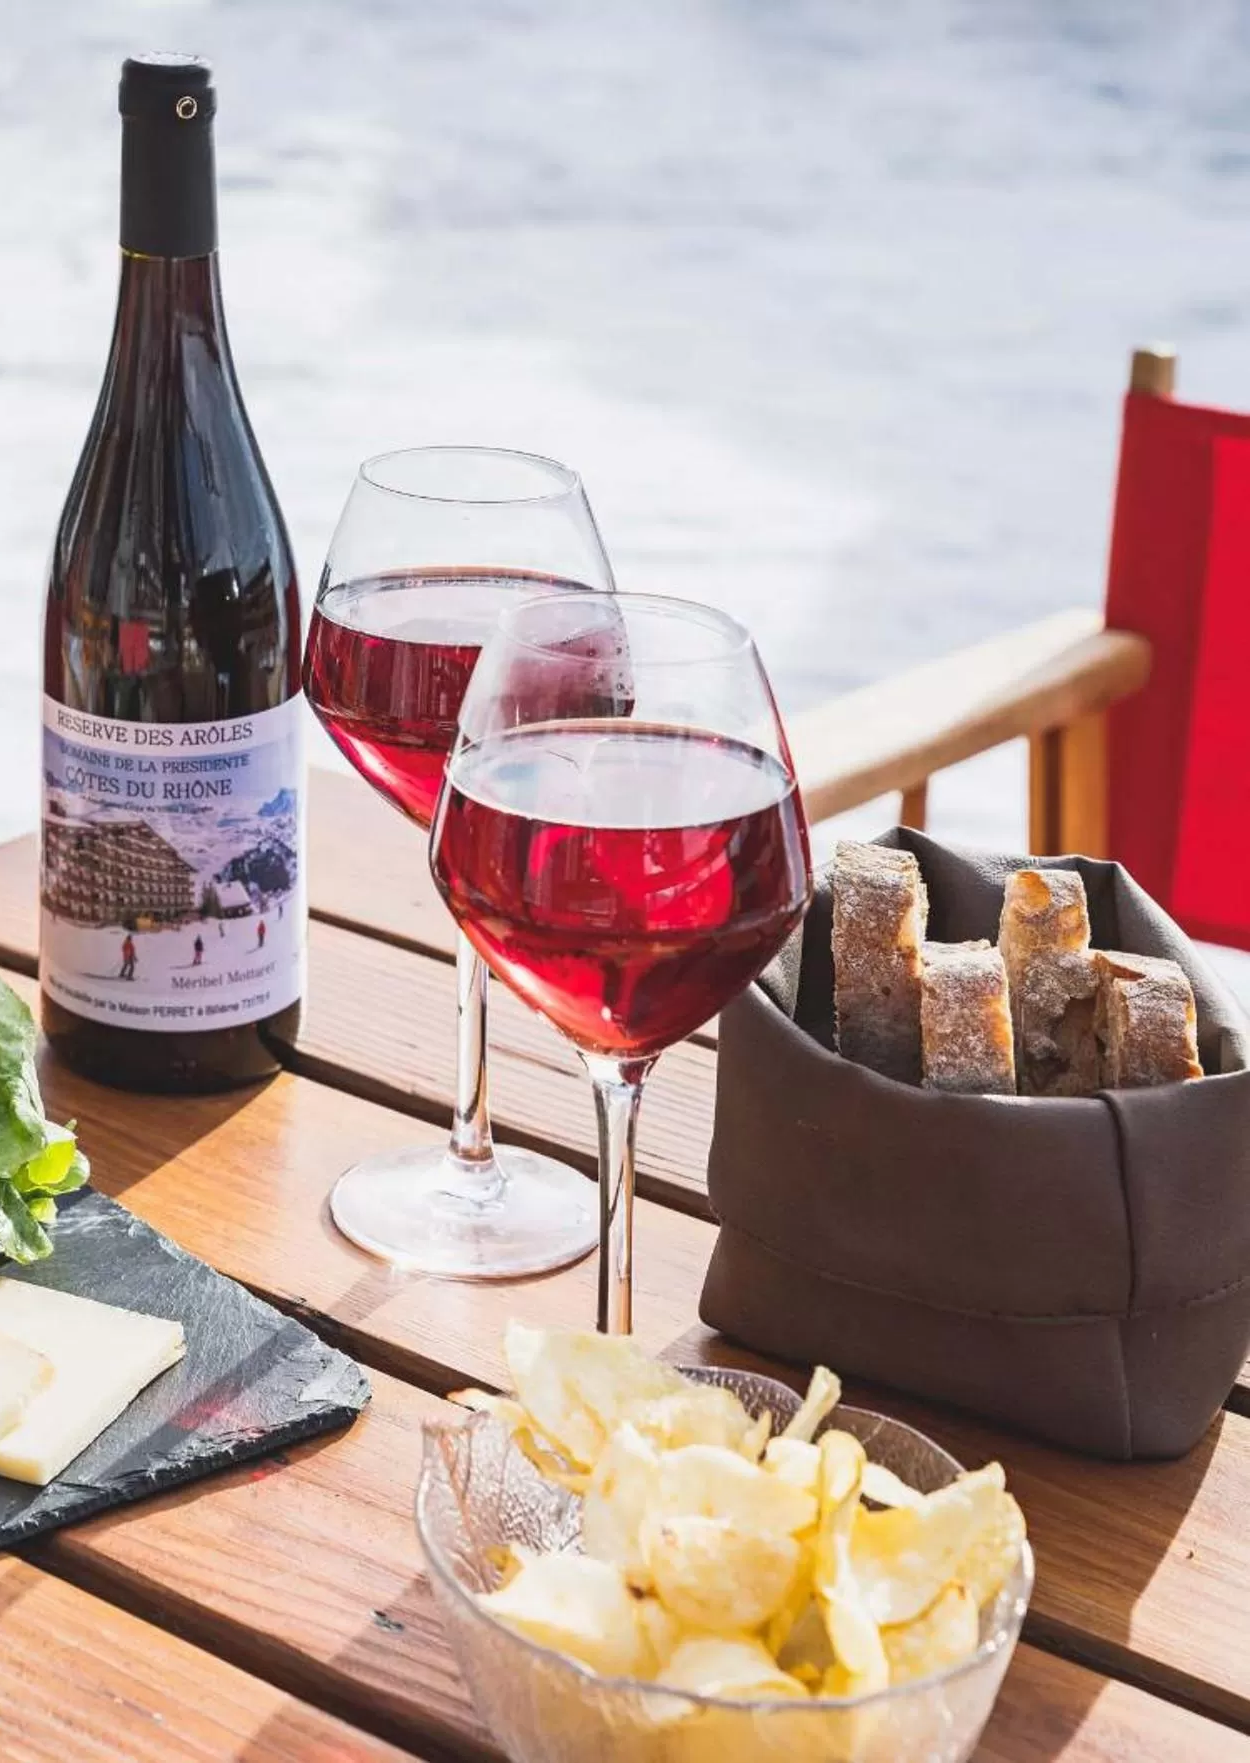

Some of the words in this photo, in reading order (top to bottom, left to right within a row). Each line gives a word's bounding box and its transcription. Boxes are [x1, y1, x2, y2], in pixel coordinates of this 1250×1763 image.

[57, 708, 128, 743] RESERVE
[134, 729, 175, 747] DES
[180, 722, 253, 746] ARÔLES
[114, 756, 134, 772] DE
[138, 760, 157, 773] LA
[162, 753, 250, 774] PRESIDENTE
[66, 764, 120, 795] CÔTES
[126, 780, 155, 799] DU
[163, 778, 233, 799] RHÔNE
[171, 973, 223, 990] Méribel
[153, 1005, 195, 1018] PERRET
